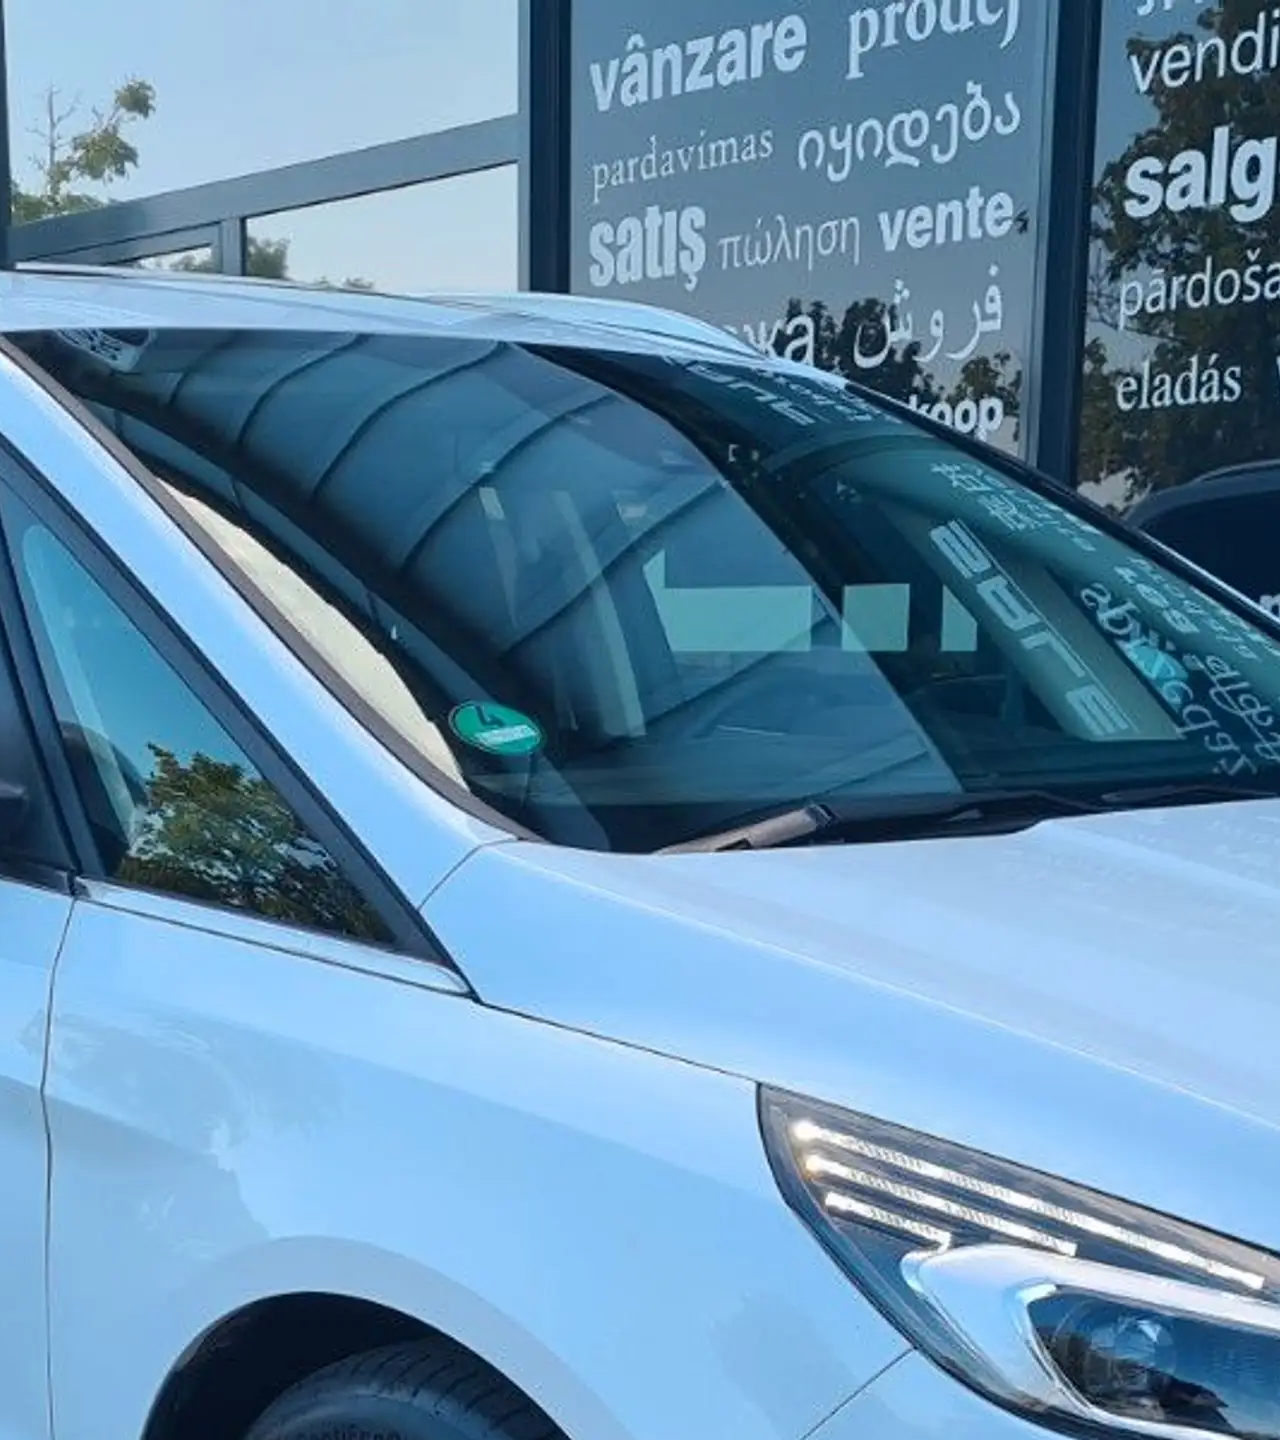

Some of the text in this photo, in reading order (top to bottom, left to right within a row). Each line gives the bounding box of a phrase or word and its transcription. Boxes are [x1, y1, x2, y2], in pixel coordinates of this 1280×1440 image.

[589, 13, 808, 112] vânzare
[592, 129, 775, 203] pardavimas
[798, 81, 1020, 182] იყიდება
[1122, 125, 1278, 221] salg
[588, 203, 707, 291] satış
[718, 214, 861, 271] πώληση
[877, 185, 1015, 252] vente
[1115, 352, 1241, 411] eladás
